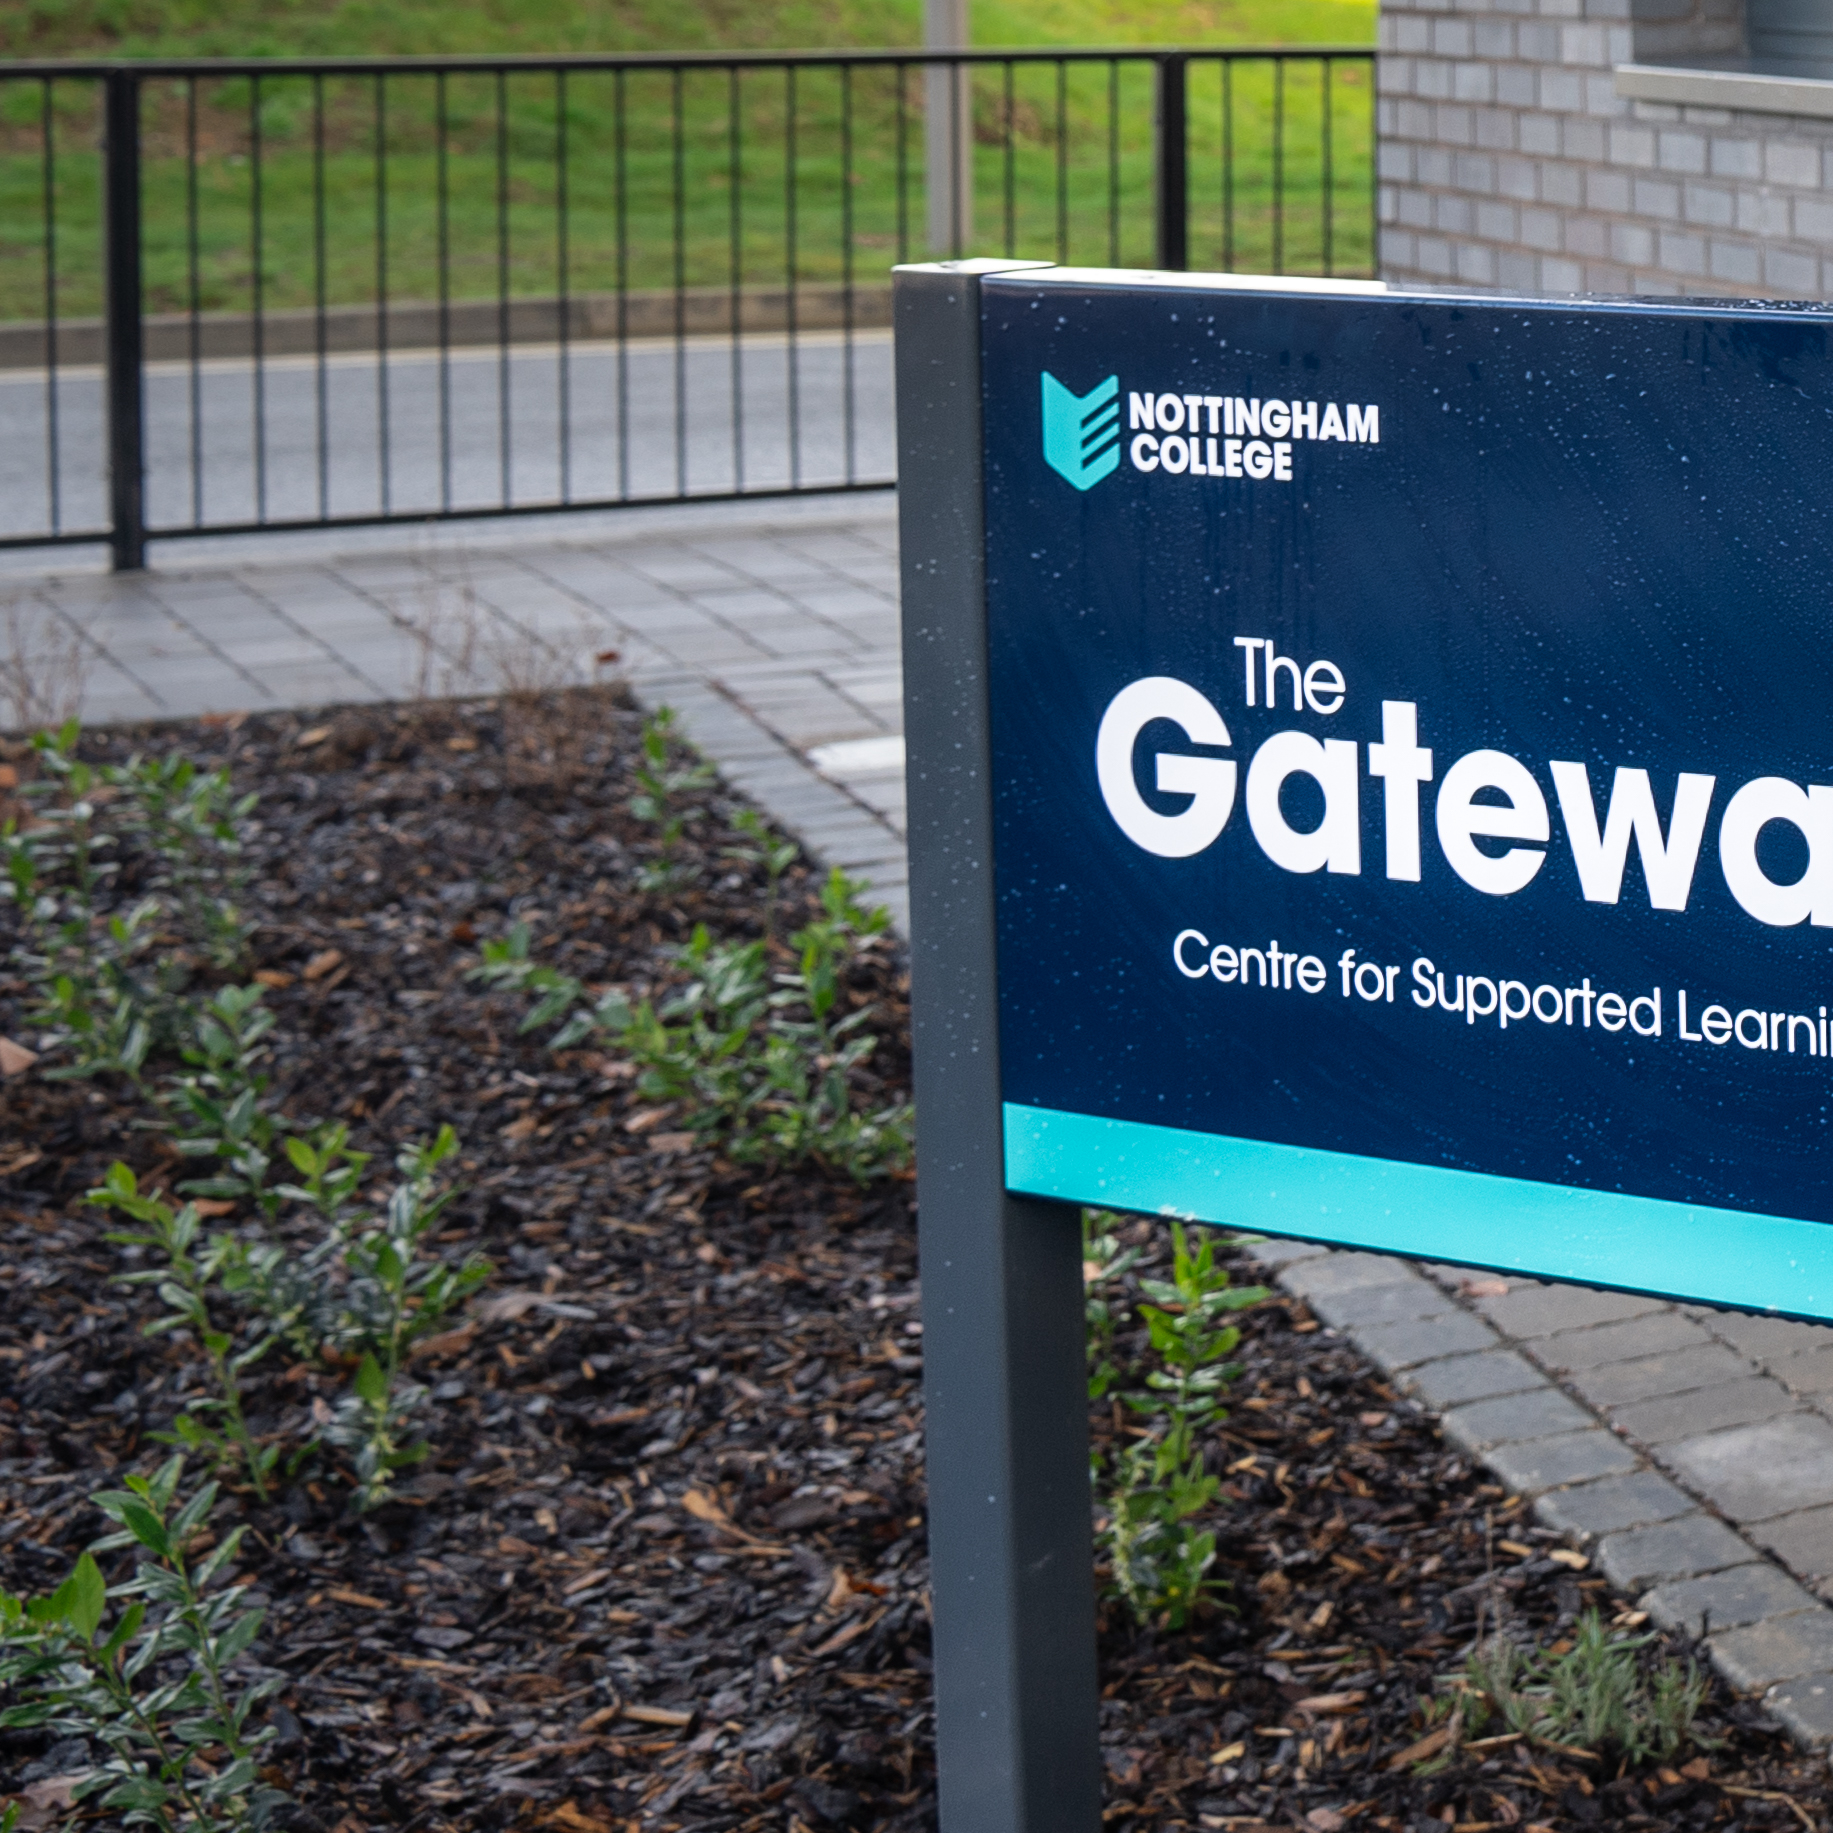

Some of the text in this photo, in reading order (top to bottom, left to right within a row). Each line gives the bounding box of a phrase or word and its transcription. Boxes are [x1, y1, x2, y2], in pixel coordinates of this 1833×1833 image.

[1129, 391, 1379, 443] NOTTINGHAM
[1130, 433, 1293, 481] COLLEGE
[1233, 636, 1346, 715] The
[1173, 929, 1327, 994] Centre
[1337, 948, 1401, 1003] for
[1411, 957, 1662, 1037] Supported
